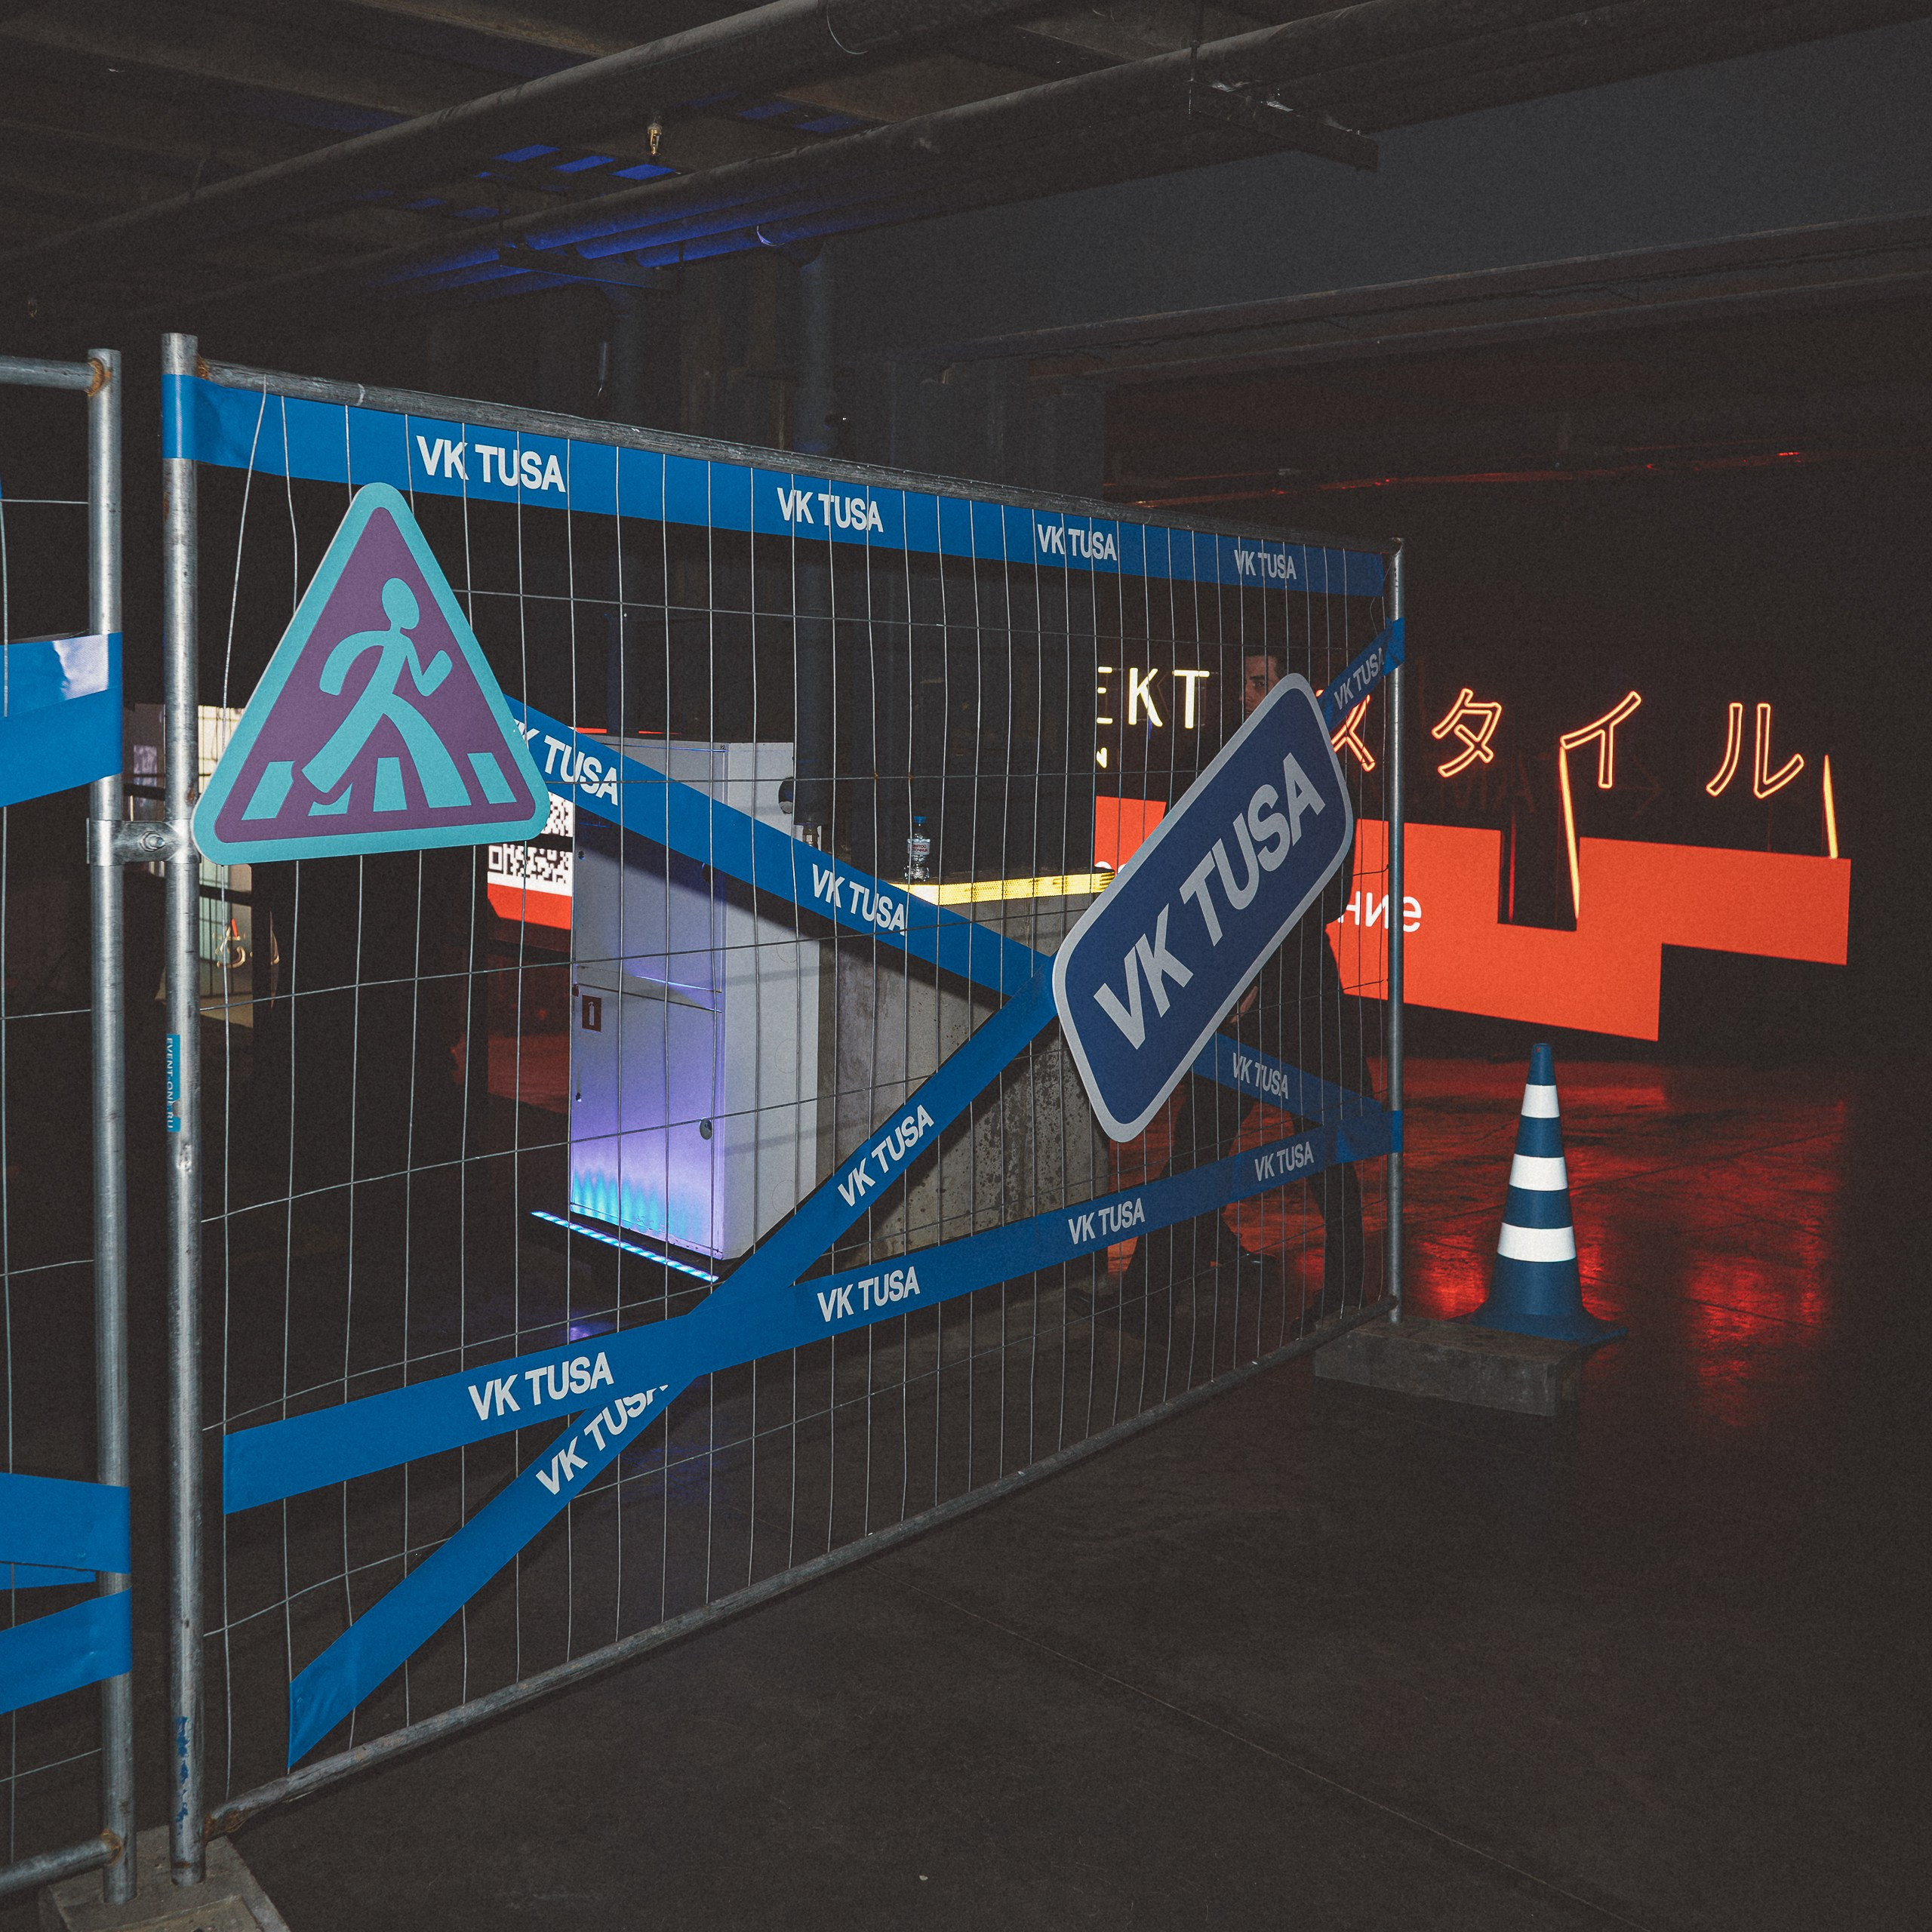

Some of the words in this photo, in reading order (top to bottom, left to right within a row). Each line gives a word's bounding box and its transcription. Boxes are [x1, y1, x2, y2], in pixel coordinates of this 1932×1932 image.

[416, 435, 469, 481] VK
[475, 444, 566, 493] TUSA
[777, 488, 814, 525] VK
[817, 493, 884, 533] TUSA
[1037, 524, 1065, 555] VK
[1068, 528, 1118, 561] TUSA
[1234, 549, 1257, 576] VK
[1257, 552, 1297, 580] TUSA
[1334, 678, 1355, 710] VK
[543, 734, 619, 806] TUSA
[812, 863, 845, 909] VK
[849, 881, 905, 937] TUSA
[1093, 903, 1194, 1051] VK
[1179, 752, 1326, 947] TUSA
[1232, 1052, 1253, 1084] VK
[1254, 1061, 1289, 1100] TUSA
[837, 1157, 876, 1208] VK
[871, 1104, 935, 1174] TUSA
[1254, 1153, 1275, 1182] VK
[1276, 1141, 1315, 1171] TUSA
[1068, 1212, 1096, 1245] VK
[1098, 1198, 1146, 1236] TUSA
[817, 1284, 854, 1323] VK
[857, 1266, 921, 1312] TUSA
[468, 1374, 521, 1421] VK
[525, 1351, 614, 1406] TUSA
[535, 1435, 589, 1496] VK
